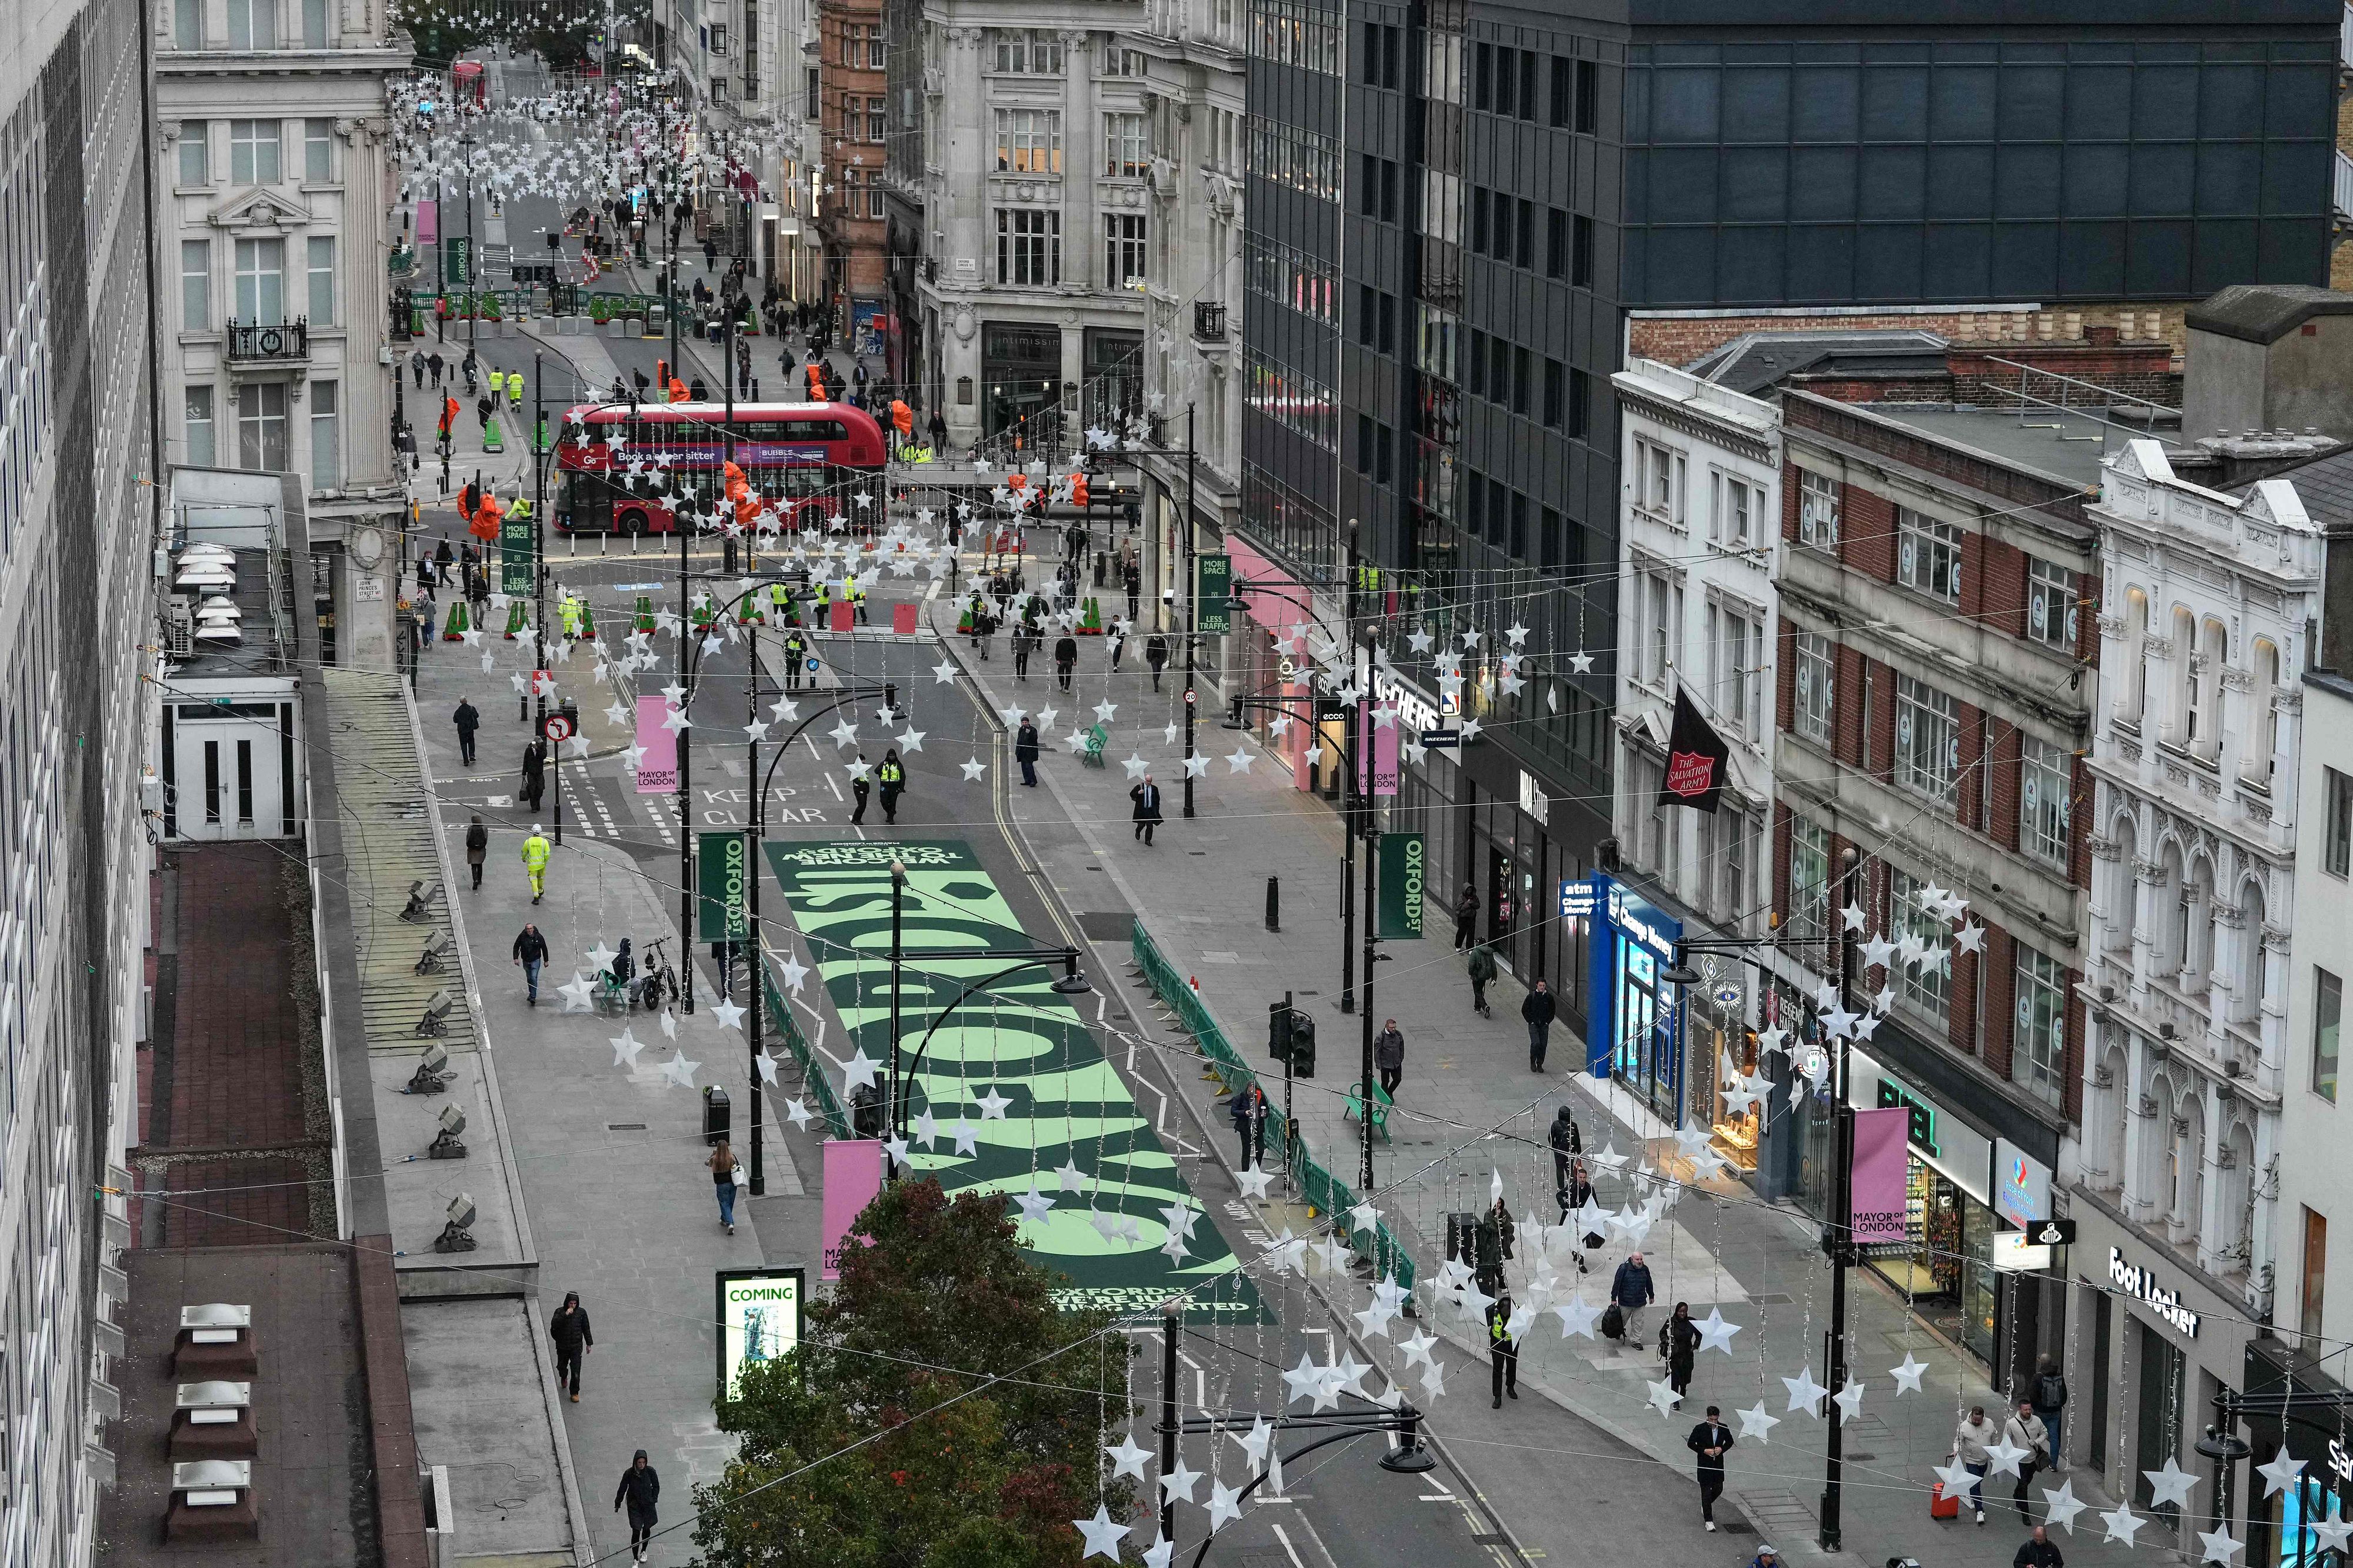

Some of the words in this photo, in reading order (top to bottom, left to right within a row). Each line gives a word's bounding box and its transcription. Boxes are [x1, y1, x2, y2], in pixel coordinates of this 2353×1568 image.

[998, 336, 1059, 346] intimissim
[584, 456, 596, 464] Go
[618, 452, 643, 461] Book
[685, 451, 715, 460] sitter
[1679, 758, 1694, 768] THE
[1669, 762, 1709, 783] SALVATION
[1680, 775, 1705, 790] ARMY
[703, 788, 796, 803] KEEP
[1519, 769, 1532, 816] NBA
[1533, 779, 1548, 827] Store
[703, 808, 827, 825] CLEAR
[726, 839, 743, 920] OXFORD
[1405, 840, 1422, 918] OXFORD
[1565, 883, 1592, 895] atm
[1562, 898, 1595, 907] Change
[1564, 906, 1592, 915] Money
[1619, 906, 1648, 941] Change
[1648, 925, 1673, 962] Money
[1779, 996, 1804, 1026] REGEN
[2005, 1180, 2017, 1195] Rose
[2018, 1189, 2024, 1199] of
[2024, 1192, 2034, 1207] York
[2003, 1191, 2019, 1213] English
[2021, 1203, 2037, 1220] School
[1854, 1212, 1892, 1222] MAYOR
[1854, 1223, 1903, 1232] LONDON
[730, 1287, 792, 1302] COMING
[2109, 1246, 2142, 1298] Foot
[2145, 1272, 2198, 1339] Locker
[1128, 1303, 1250, 1312] STRTED
